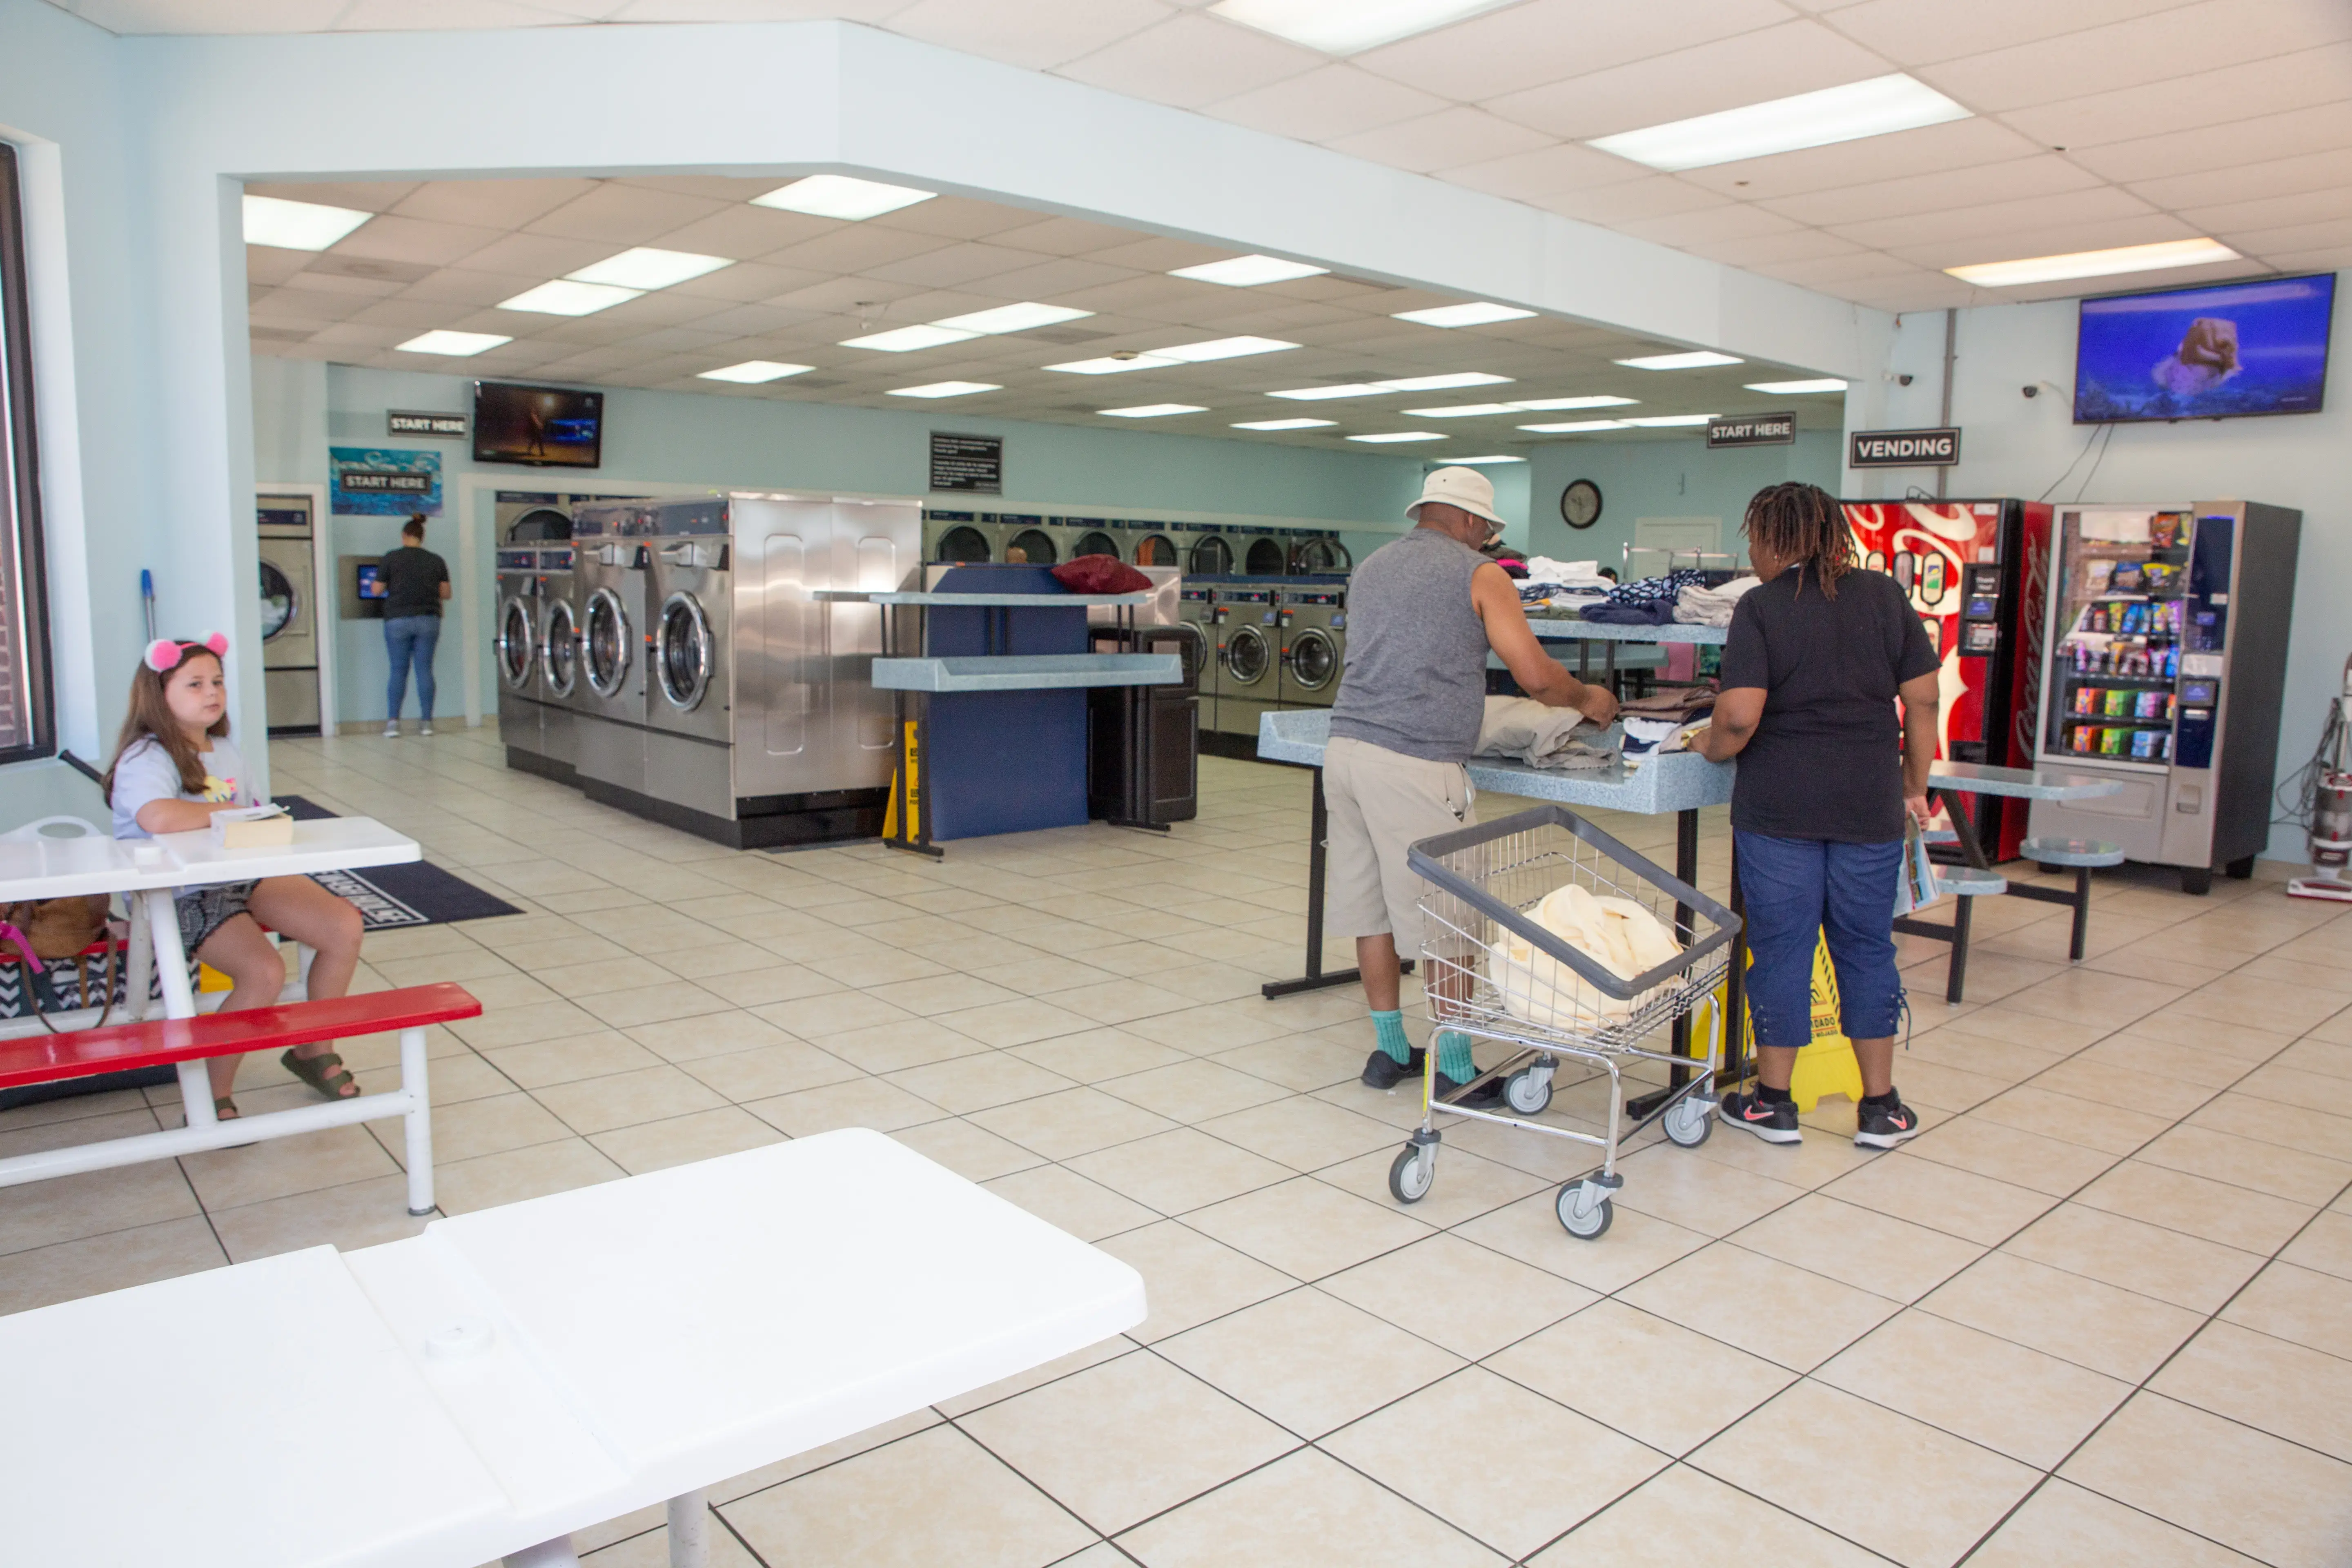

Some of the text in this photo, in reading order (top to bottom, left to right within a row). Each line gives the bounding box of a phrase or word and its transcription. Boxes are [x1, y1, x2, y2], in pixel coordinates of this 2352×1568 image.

[391, 417, 465, 432] START HERE
[1712, 422, 1790, 439] START HERE
[1858, 438, 1952, 458] VENDING
[346, 475, 426, 489] START HERE
